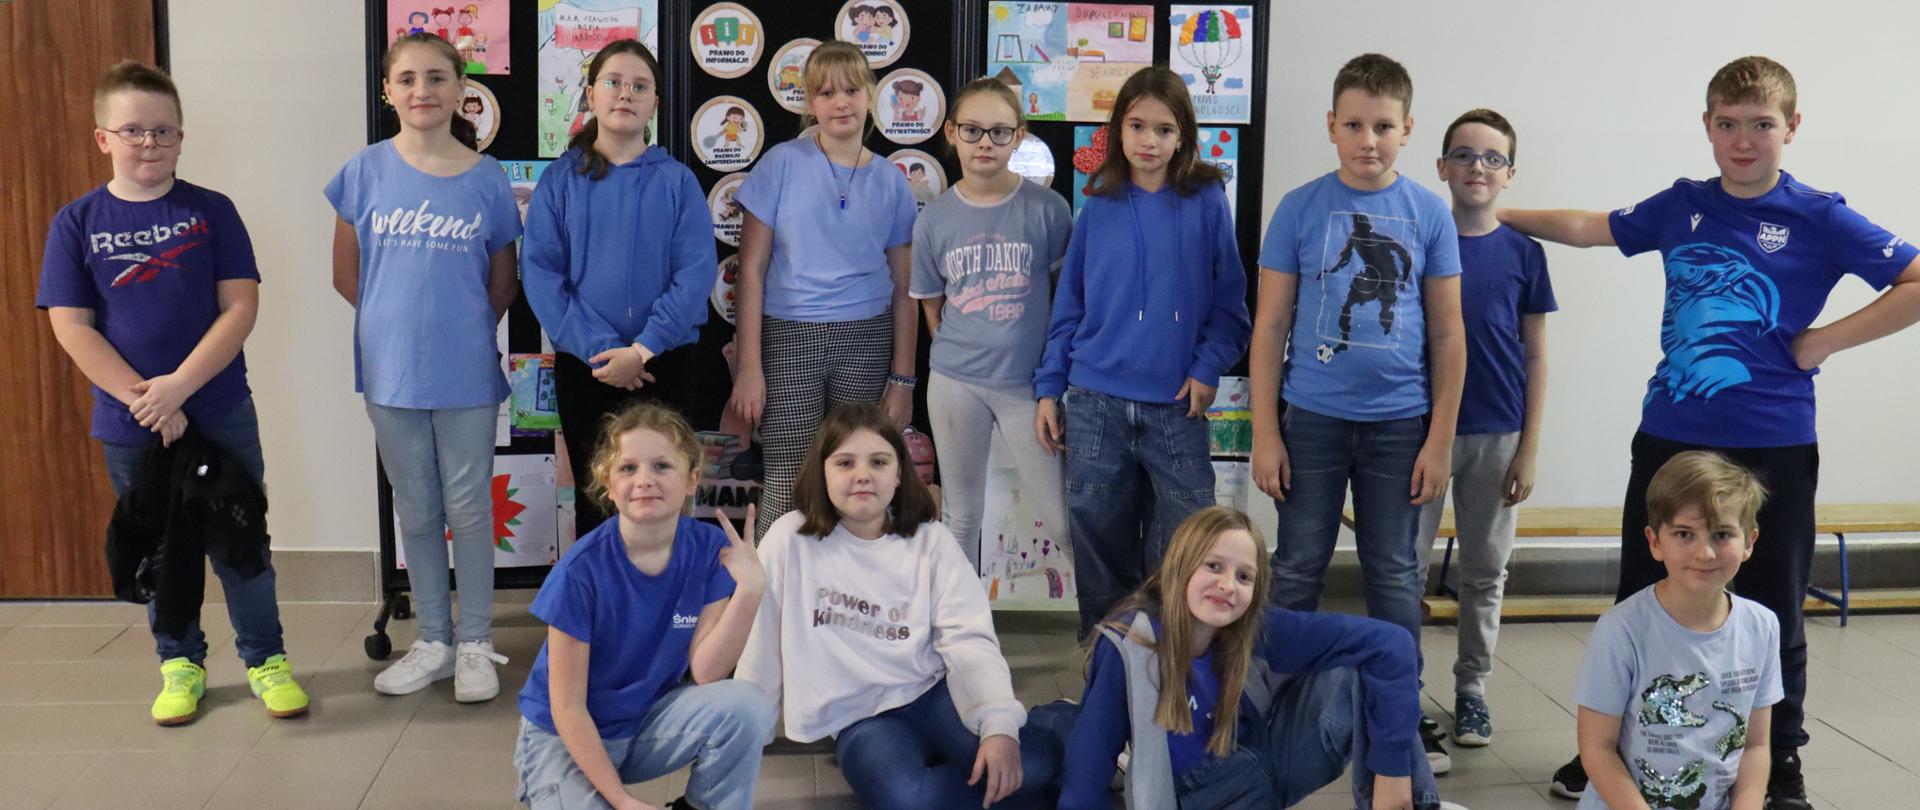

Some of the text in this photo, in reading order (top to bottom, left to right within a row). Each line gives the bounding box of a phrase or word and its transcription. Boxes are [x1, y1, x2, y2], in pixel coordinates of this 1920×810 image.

[90, 216, 209, 254] Reebok
[371, 199, 482, 240] weekend
[377, 239, 470, 253] LET'S HAVE SOME FUN
[945, 241, 1033, 285] NORTH DAKOTA
[817, 588, 882, 618] Power
